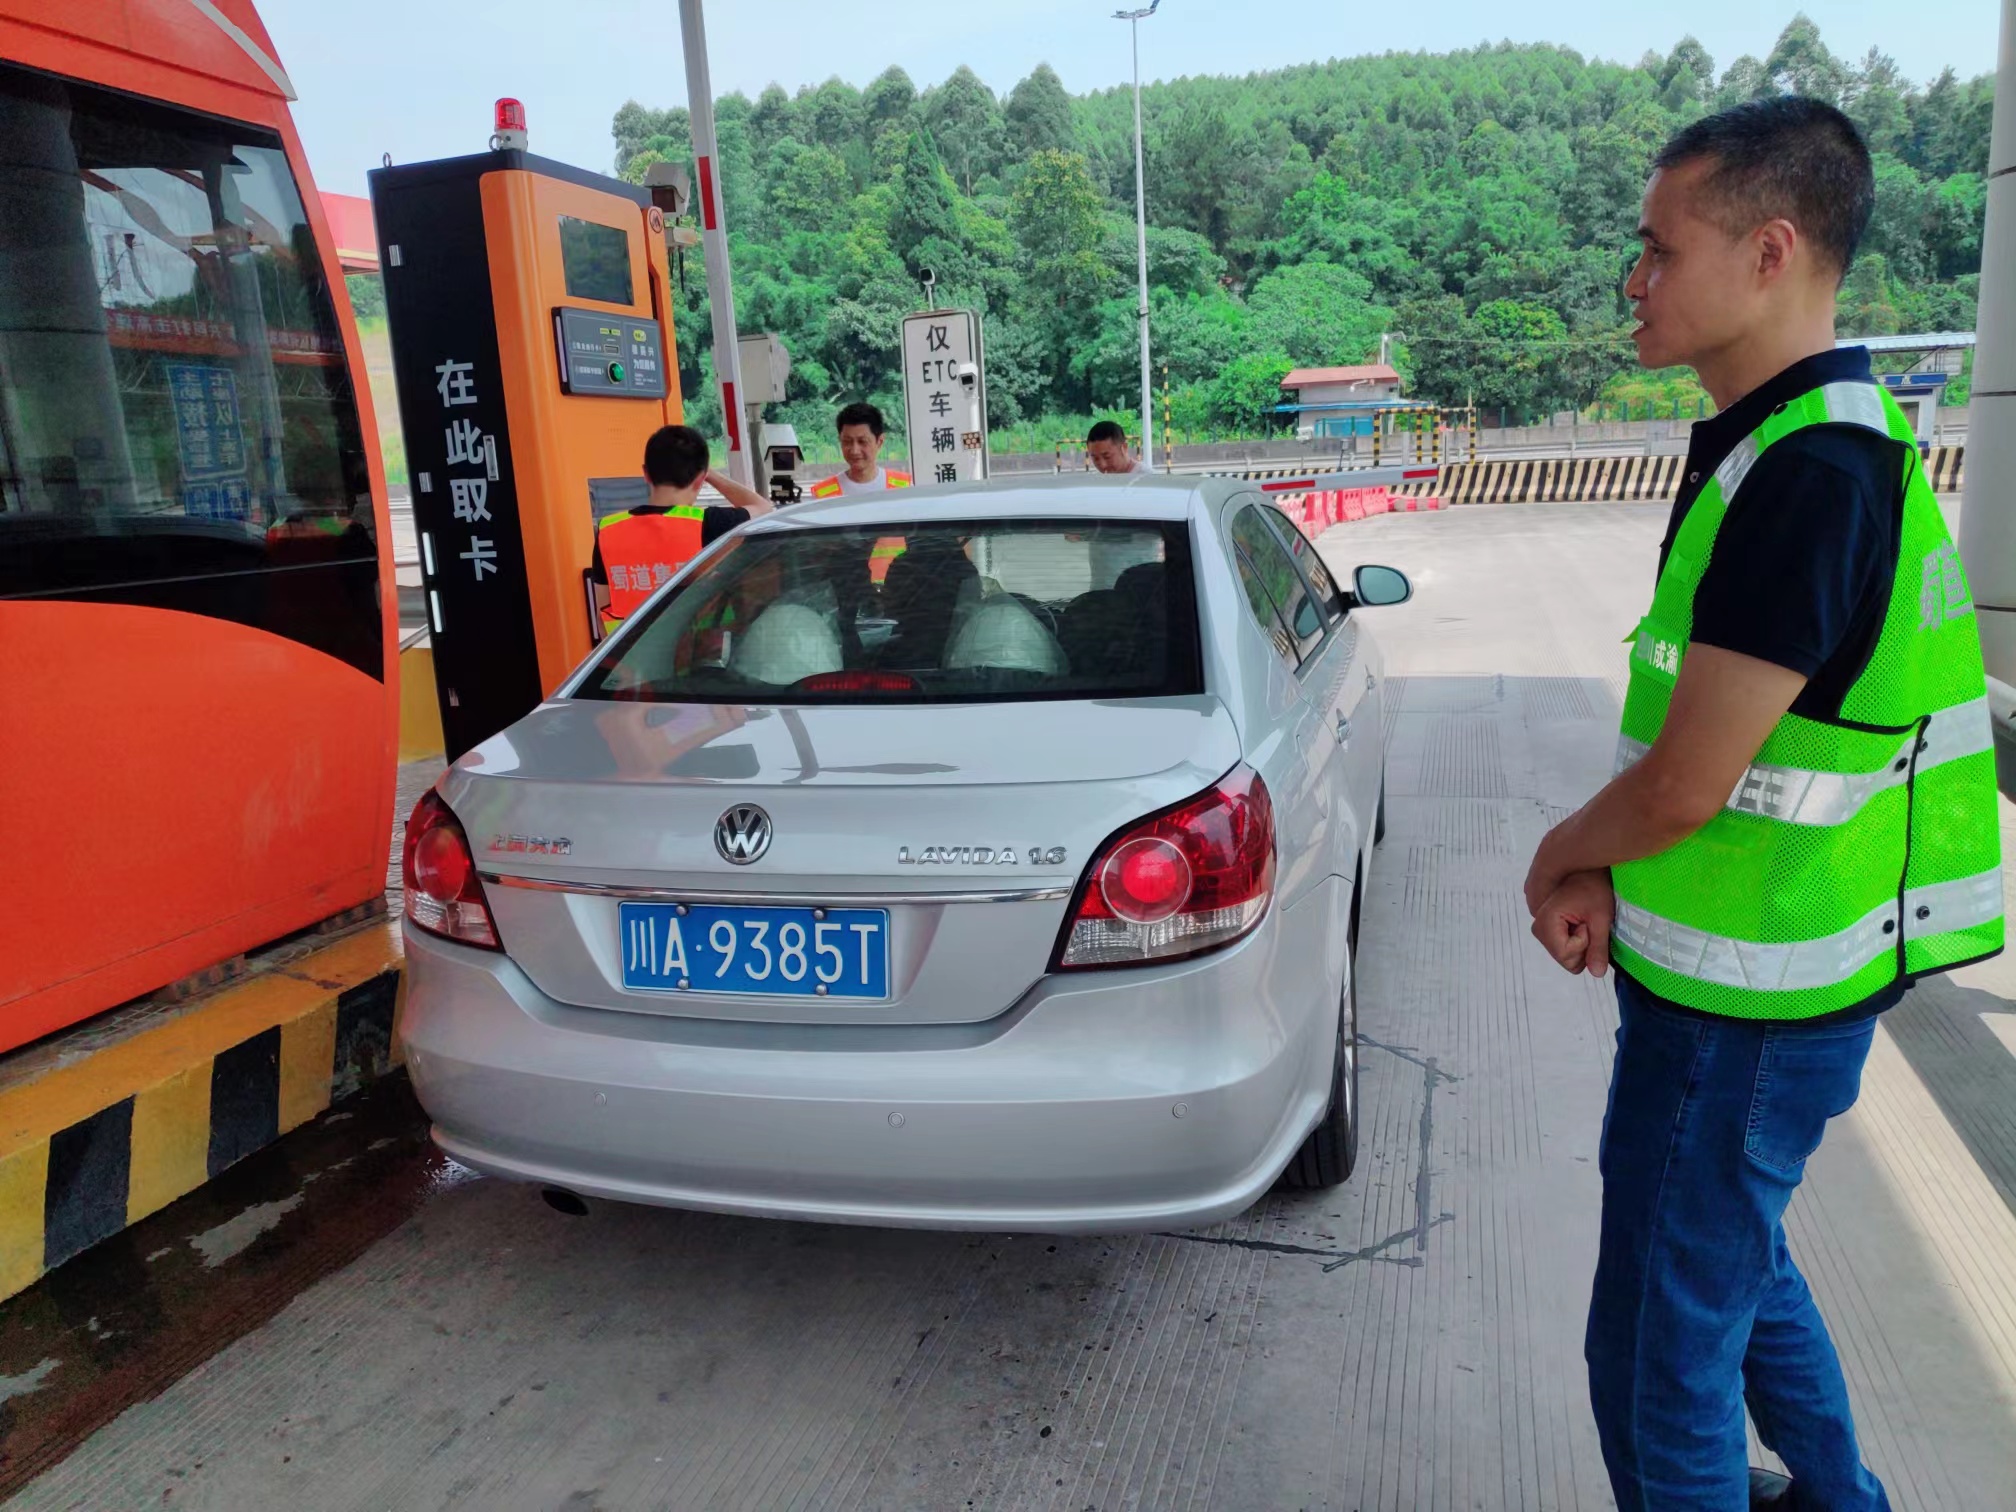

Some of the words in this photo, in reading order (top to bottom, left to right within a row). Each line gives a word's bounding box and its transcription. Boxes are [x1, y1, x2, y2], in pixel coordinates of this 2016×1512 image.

[435, 359, 498, 581] 在此取卡
[898, 846, 1018, 866] LAVIDA
